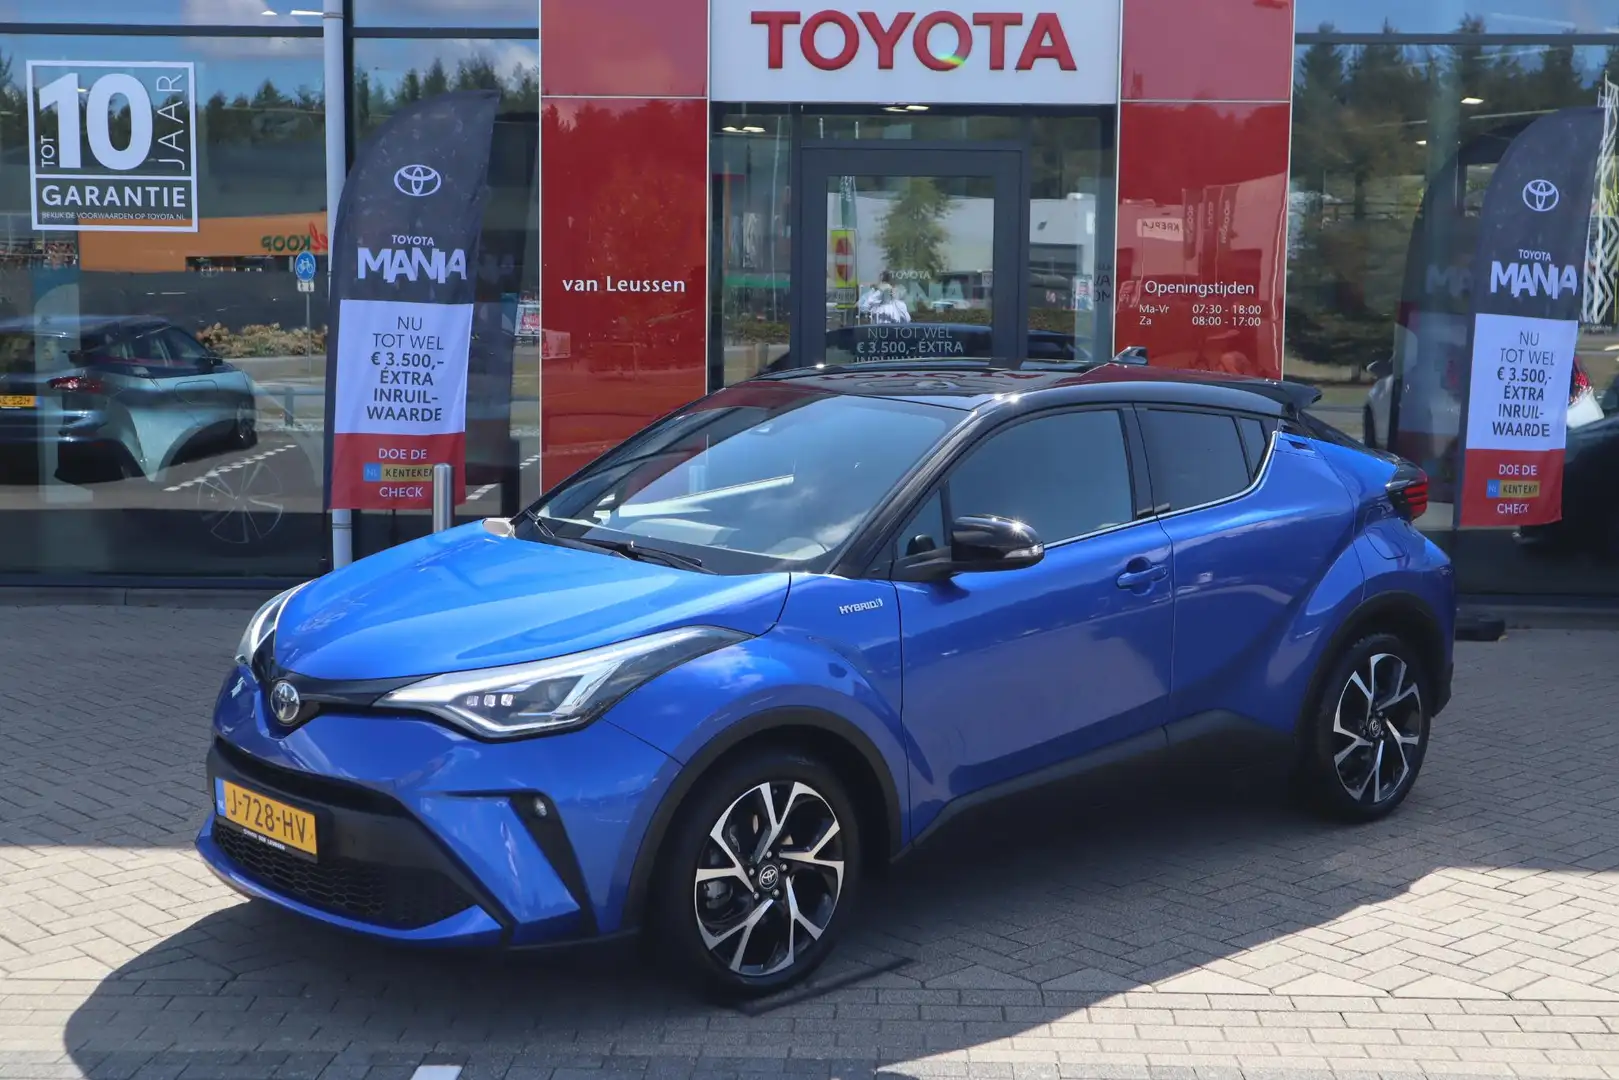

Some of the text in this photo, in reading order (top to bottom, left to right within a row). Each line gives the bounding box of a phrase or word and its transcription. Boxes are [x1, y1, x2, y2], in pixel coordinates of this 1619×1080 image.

[751, 10, 1077, 71] TOYOTA
[39, 73, 153, 171] 10
[156, 74, 185, 171] JAAR
[40, 135, 55, 168] TOT
[42, 185, 186, 207] GARANTIE
[76, 212, 134, 220] VOORWAARDEN
[391, 234, 435, 247] TOYOTA
[1518, 248, 1552, 261] TOYOTA
[357, 246, 467, 284] MANIA
[889, 270, 931, 280] TOYOTA
[1490, 260, 1578, 299] MANIA
[562, 275, 686, 293] van Leussen
[1144, 280, 1255, 298] Openingstijden
[1139, 304, 1170, 314] Ma-Vr
[1192, 304, 1222, 315] 07:30
[1232, 304, 1262, 315] 18:00
[397, 316, 423, 331] NU
[1139, 315, 1152, 326] Za
[1191, 316, 1222, 326] 08:00
[1232, 316, 1262, 327] 17:00
[868, 328, 952, 338] NU TOT WEL
[1519, 331, 1540, 346] NU
[372, 333, 445, 351] TOT WEL
[857, 341, 865, 353] €
[370, 351, 445, 370] € 3.500,-
[1500, 347, 1555, 366] TOT WEL
[1497, 366, 1552, 385] € 3.500,-
[373, 388, 439, 404] INRUIL-
[366, 405, 443, 422] WAARDE
[1498, 403, 1544, 419] INRUIL-
[1492, 421, 1551, 437] WAARDE
[378, 448, 428, 460] DOE DE
[366, 468, 378, 477] NL
[1498, 464, 1538, 476] DOE DE
[379, 486, 424, 498] CHECK
[1496, 503, 1529, 514] CHECK
[839, 600, 879, 615] HYBRID
[230, 788, 306, 844] J-728-HV
